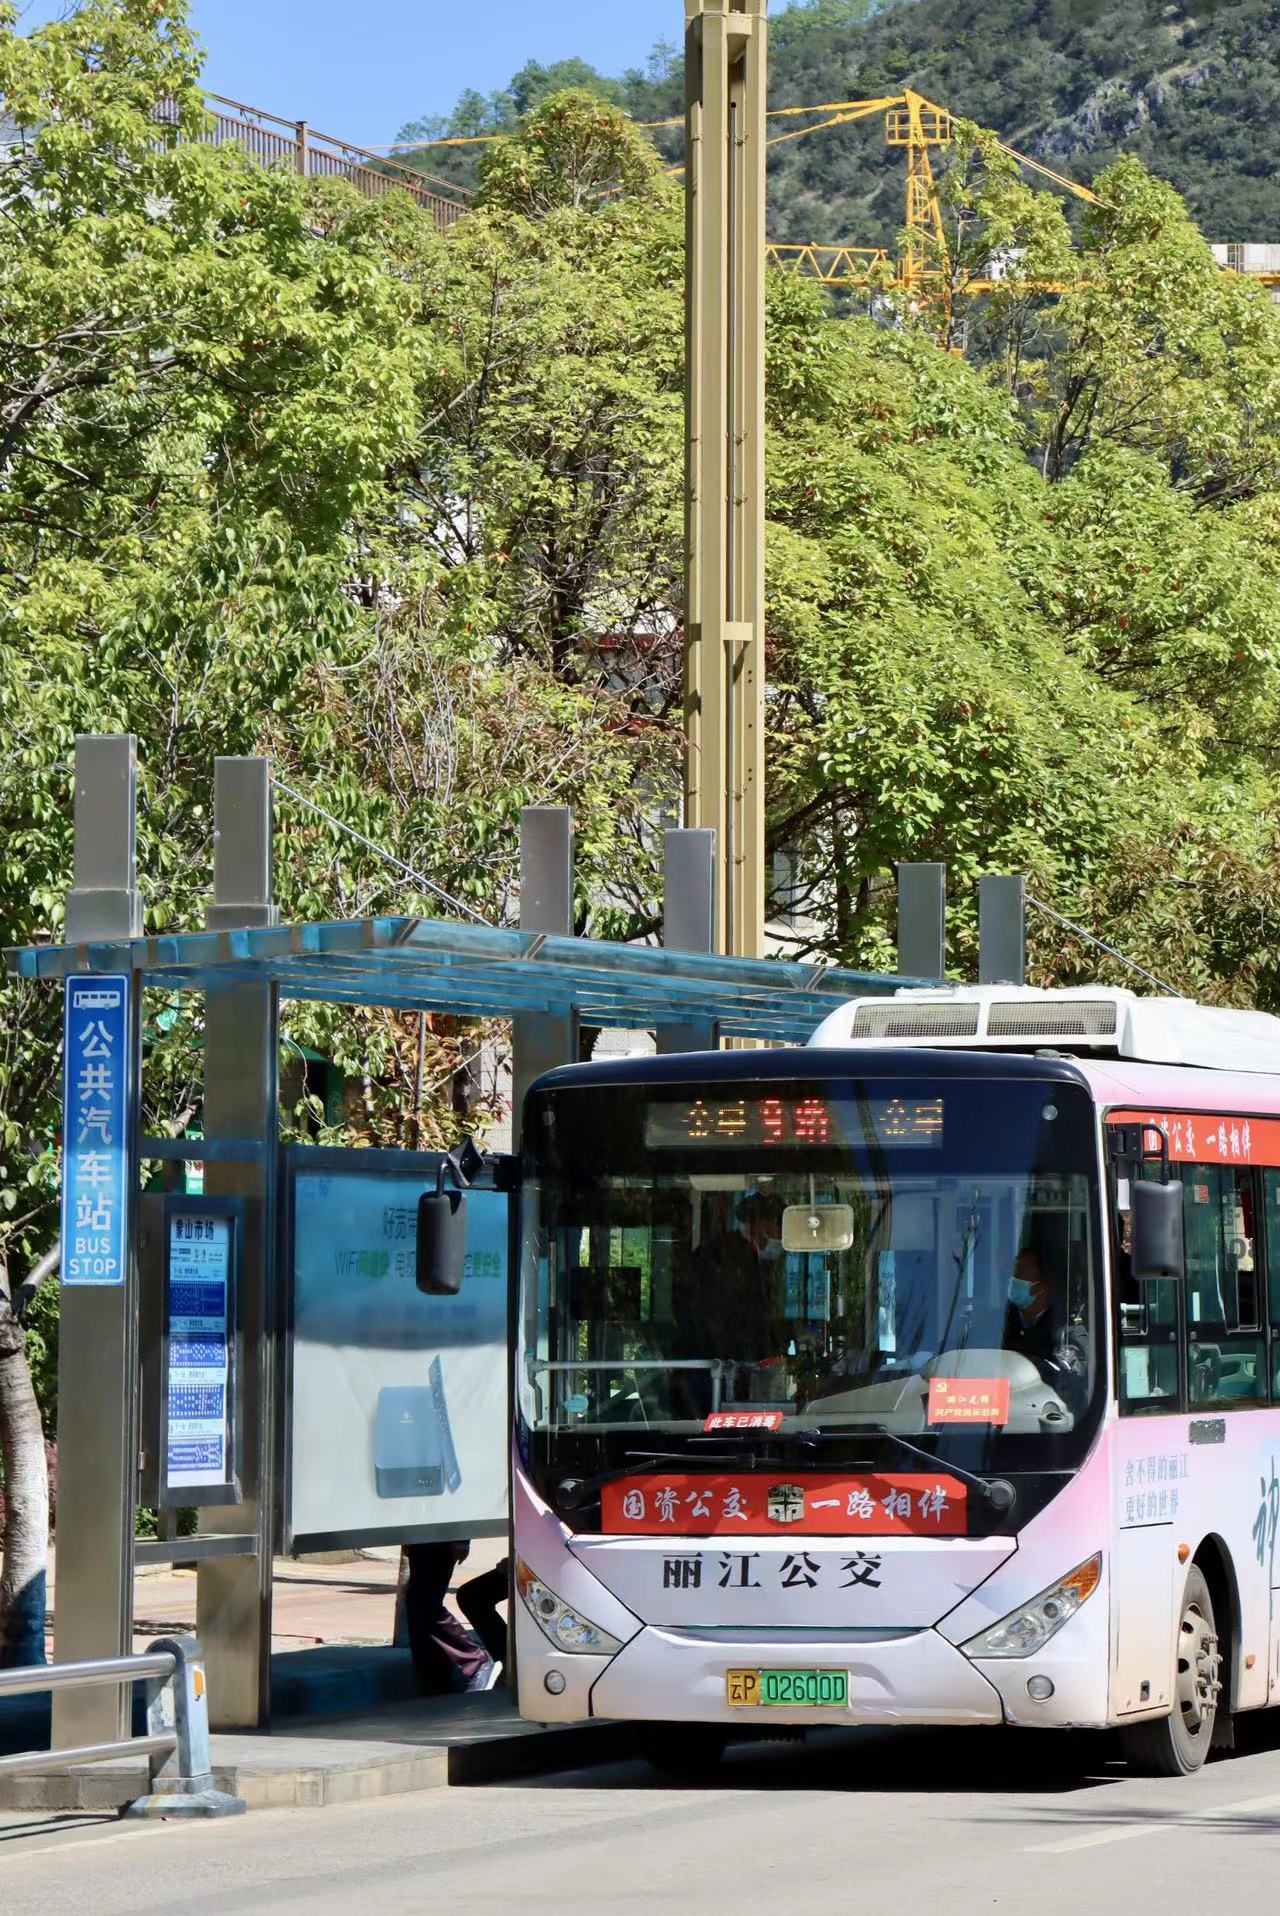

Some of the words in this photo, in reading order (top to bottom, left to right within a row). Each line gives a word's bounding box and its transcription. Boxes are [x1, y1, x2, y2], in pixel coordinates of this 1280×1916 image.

[76, 1021, 113, 1231] 公共汽车站
[1206, 1120, 1251, 1161] 一路相伴
[176, 1219, 214, 1240] 象山市场
[75, 1237, 110, 1255] BUS
[69, 1257, 116, 1275] STOP
[709, 1414, 777, 1428] 此车已消毒
[935, 1407, 1000, 1417] 共产党员示范岗
[1125, 1453, 1190, 1487] 舍不得的丽江
[622, 1487, 749, 1522] 国资公交
[810, 1487, 951, 1523] 一路相伴
[662, 1551, 882, 1589] 丽江公交
